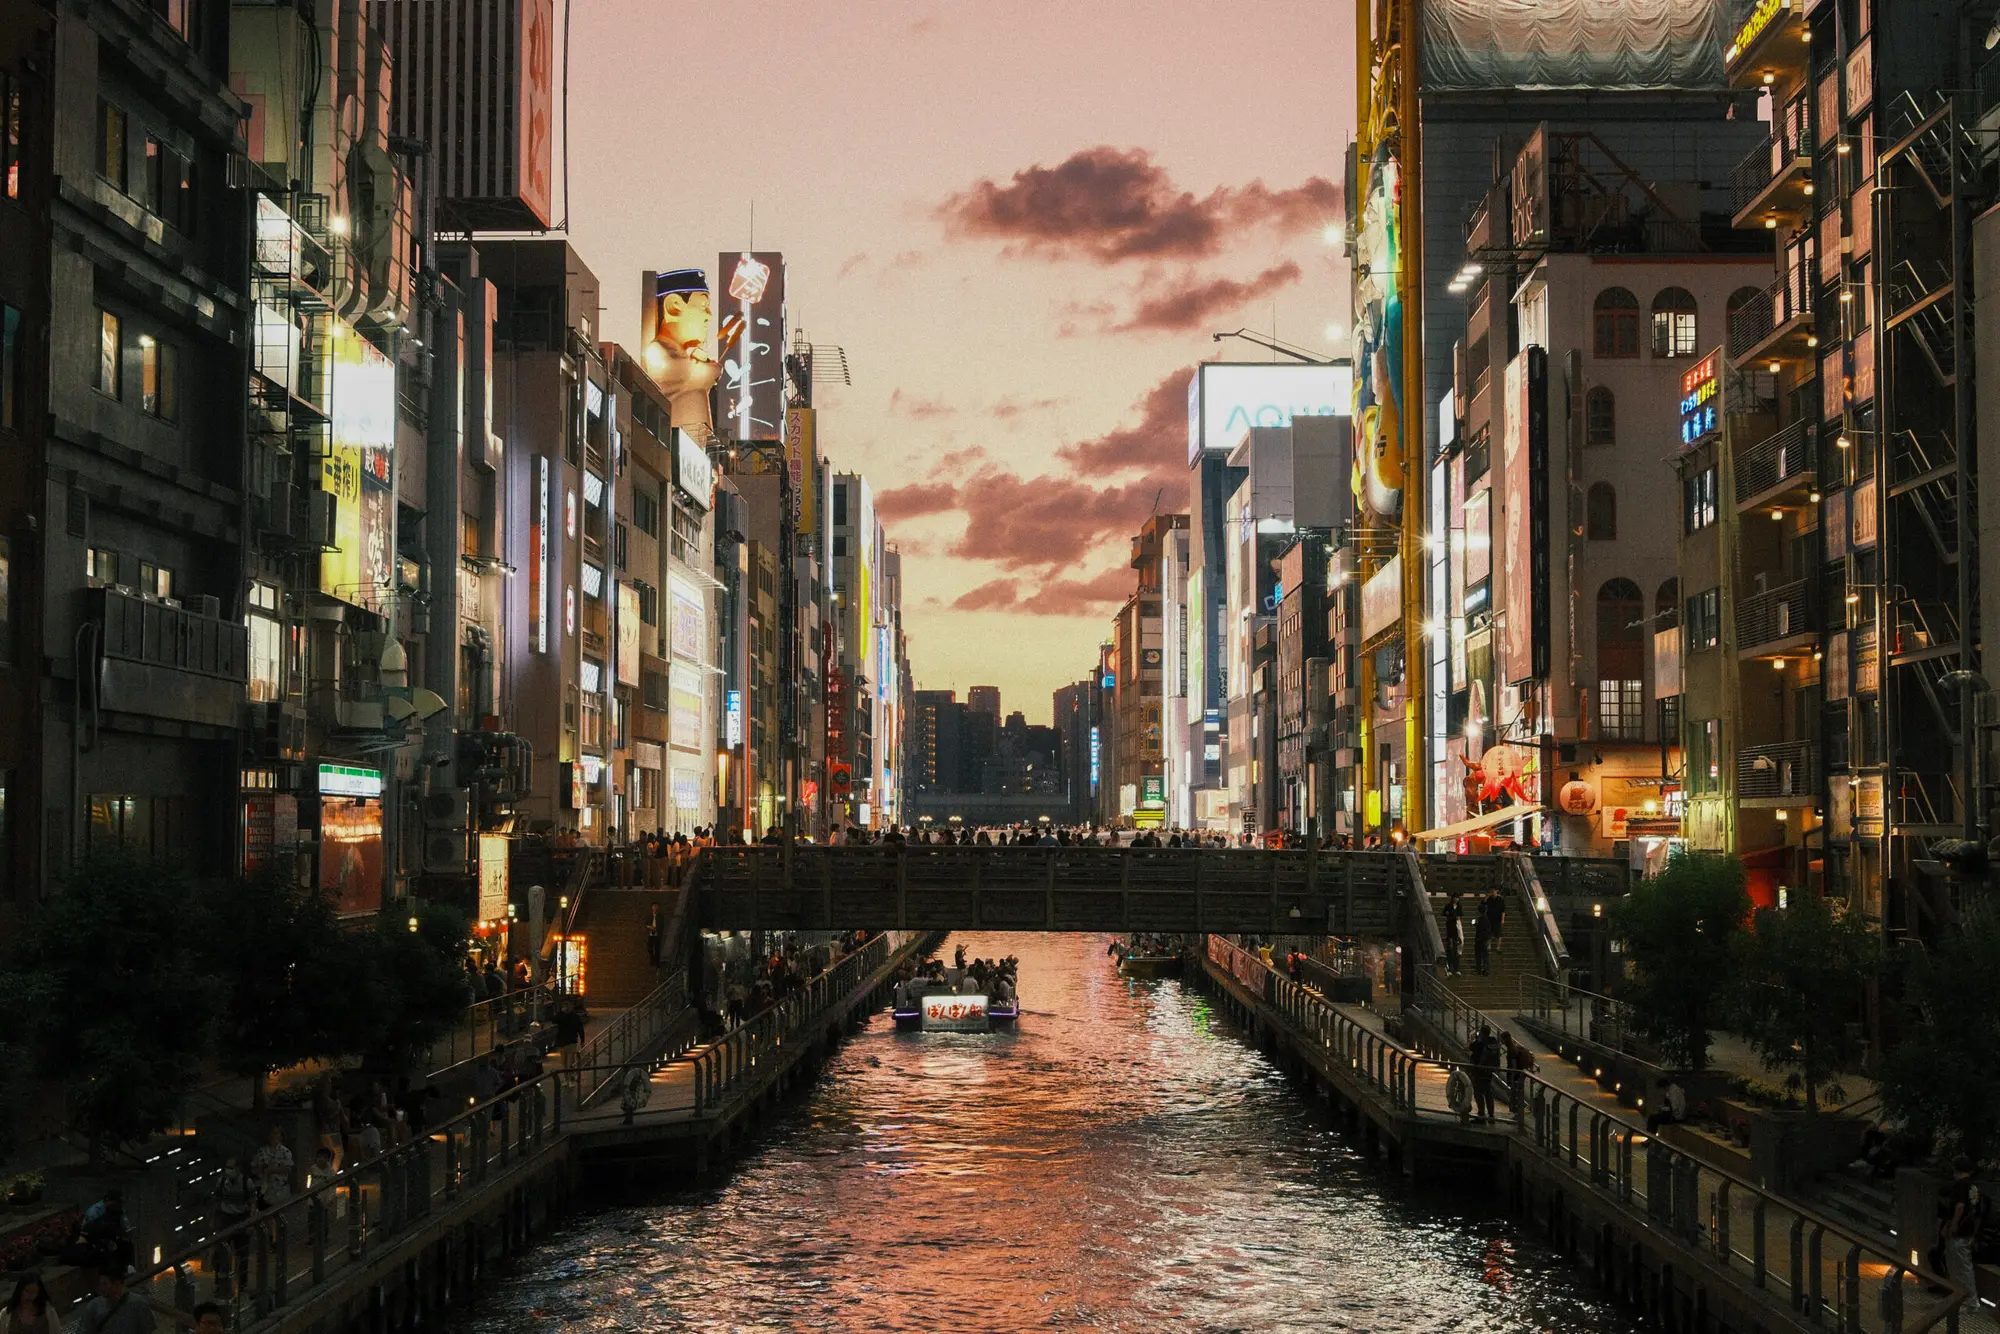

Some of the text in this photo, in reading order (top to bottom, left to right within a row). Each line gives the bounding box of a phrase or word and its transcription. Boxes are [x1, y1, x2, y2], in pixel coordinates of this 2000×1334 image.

[927, 1002, 984, 1019] ぽんぽん船
